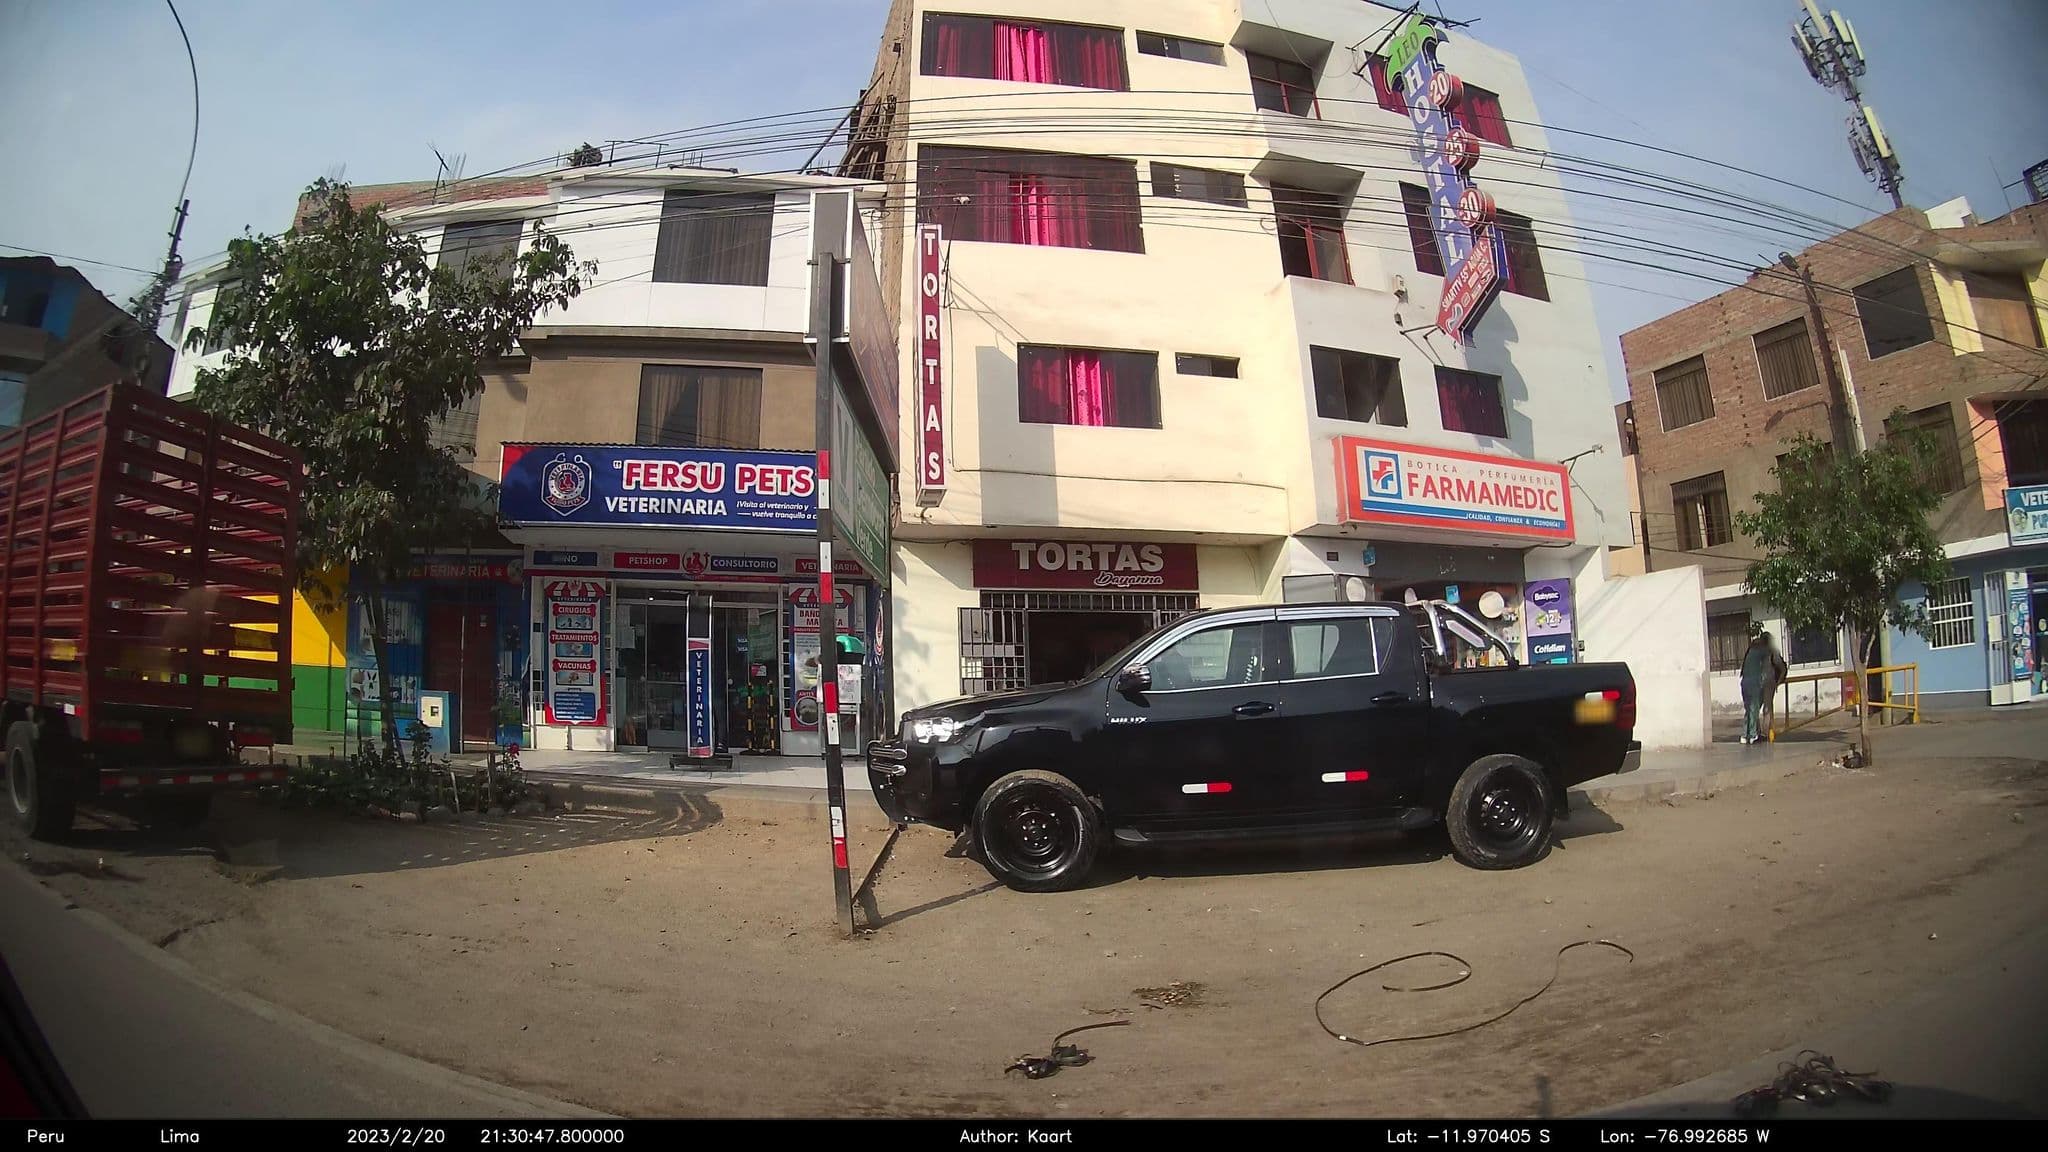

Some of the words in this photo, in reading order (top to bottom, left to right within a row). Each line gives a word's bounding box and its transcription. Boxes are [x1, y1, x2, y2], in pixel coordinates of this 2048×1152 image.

[1397, 31, 1419, 66] LEO
[1429, 73, 1448, 105] 20
[1404, 61, 1464, 266] HOSTAL
[1460, 191, 1479, 225] 30
[922, 232, 941, 481] TORTAS
[1406, 459, 1458, 473] BOTICA
[1407, 472, 1558, 512] FARMAMEDIC
[605, 496, 728, 516] VETERINARIA
[767, 502, 803, 510] veterinario
[803, 503, 809, 511] y
[775, 511, 806, 520] tranquilo
[628, 556, 668, 565] PETSHOP
[712, 559, 777, 569] CONSULTORIO
[1012, 542, 1164, 572] TORTAS
[801, 562, 859, 571] VETNARIA
[1093, 570, 1164, 588] Dayanna
[551, 634, 598, 642] TRATAMIENTOS
[1534, 644, 1566, 654] Cotidian
[557, 662, 592, 670] VACUNAS
[695, 652, 704, 744] VETERINARIA
